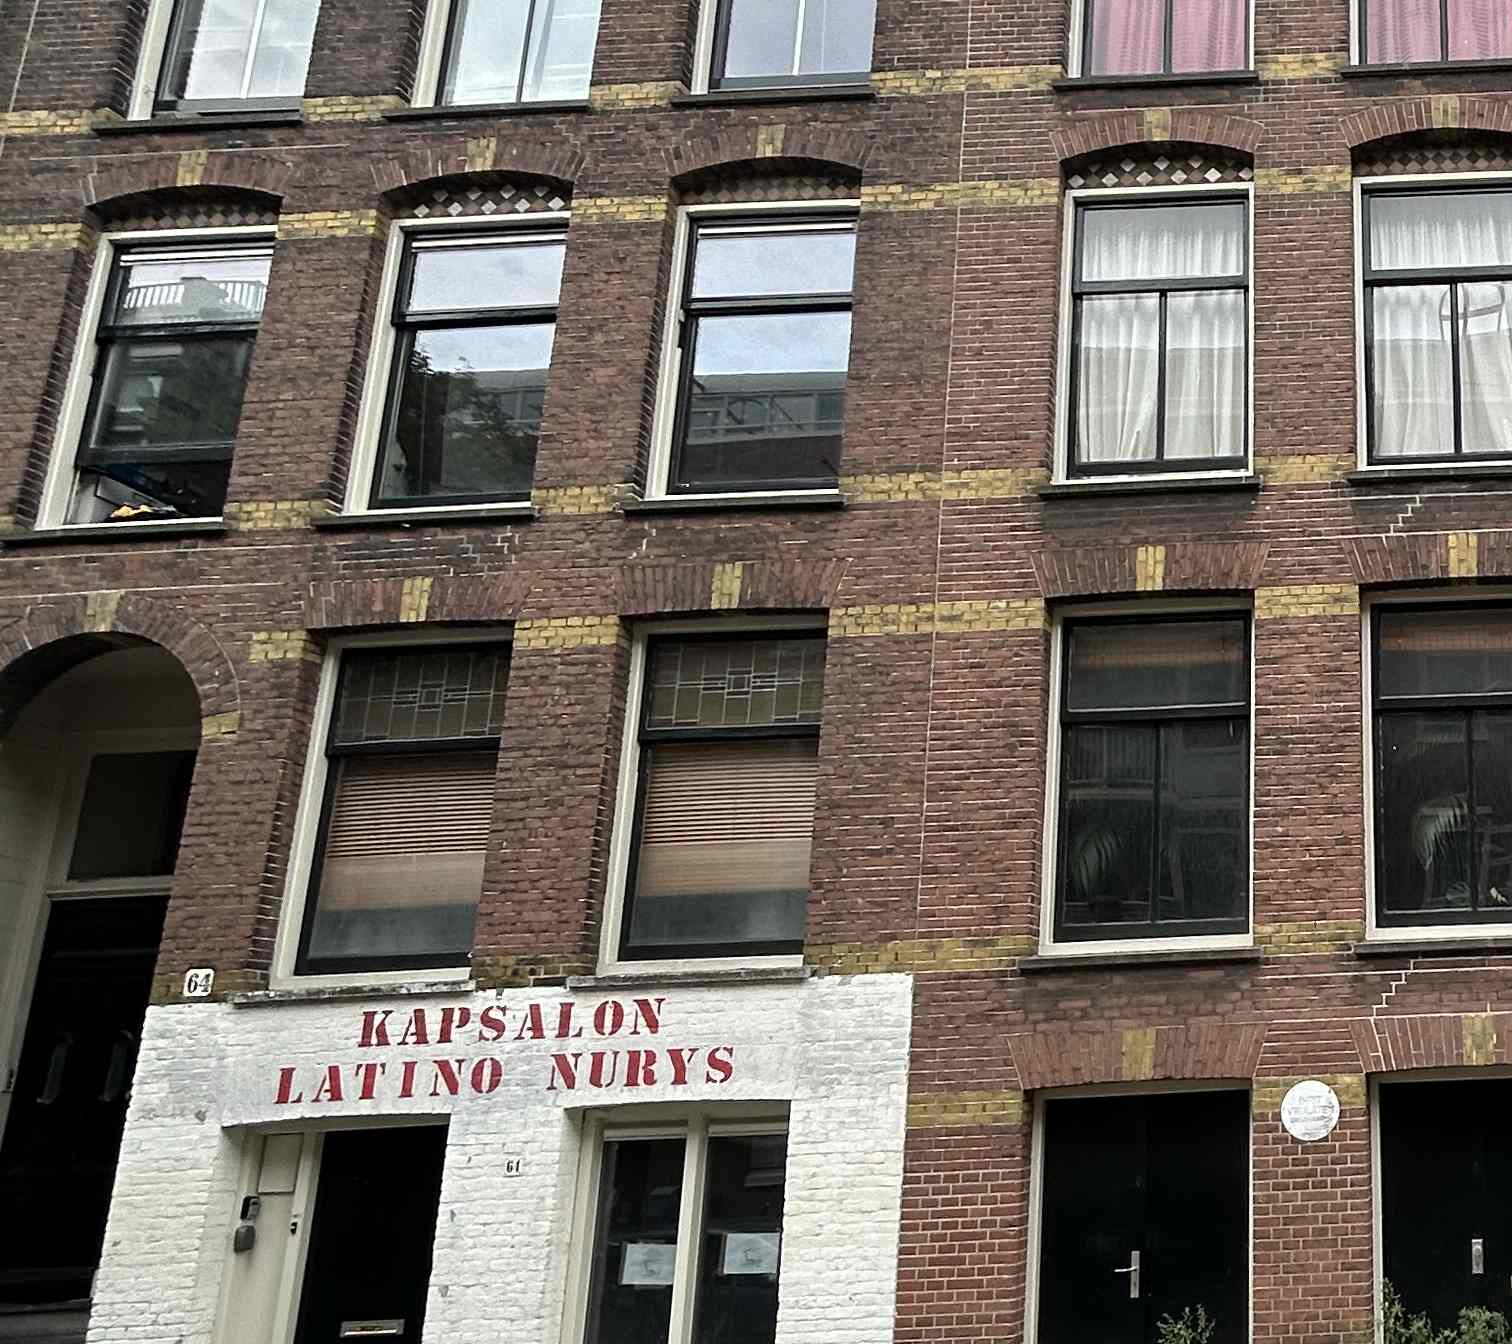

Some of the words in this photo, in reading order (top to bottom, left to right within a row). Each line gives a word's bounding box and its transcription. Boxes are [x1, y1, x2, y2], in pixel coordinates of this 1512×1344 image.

[187, 972, 211, 994] 64
[357, 998, 666, 1048] KAPSALON
[273, 1056, 503, 1105] LATINO
[547, 1046, 735, 1091] NURYS
